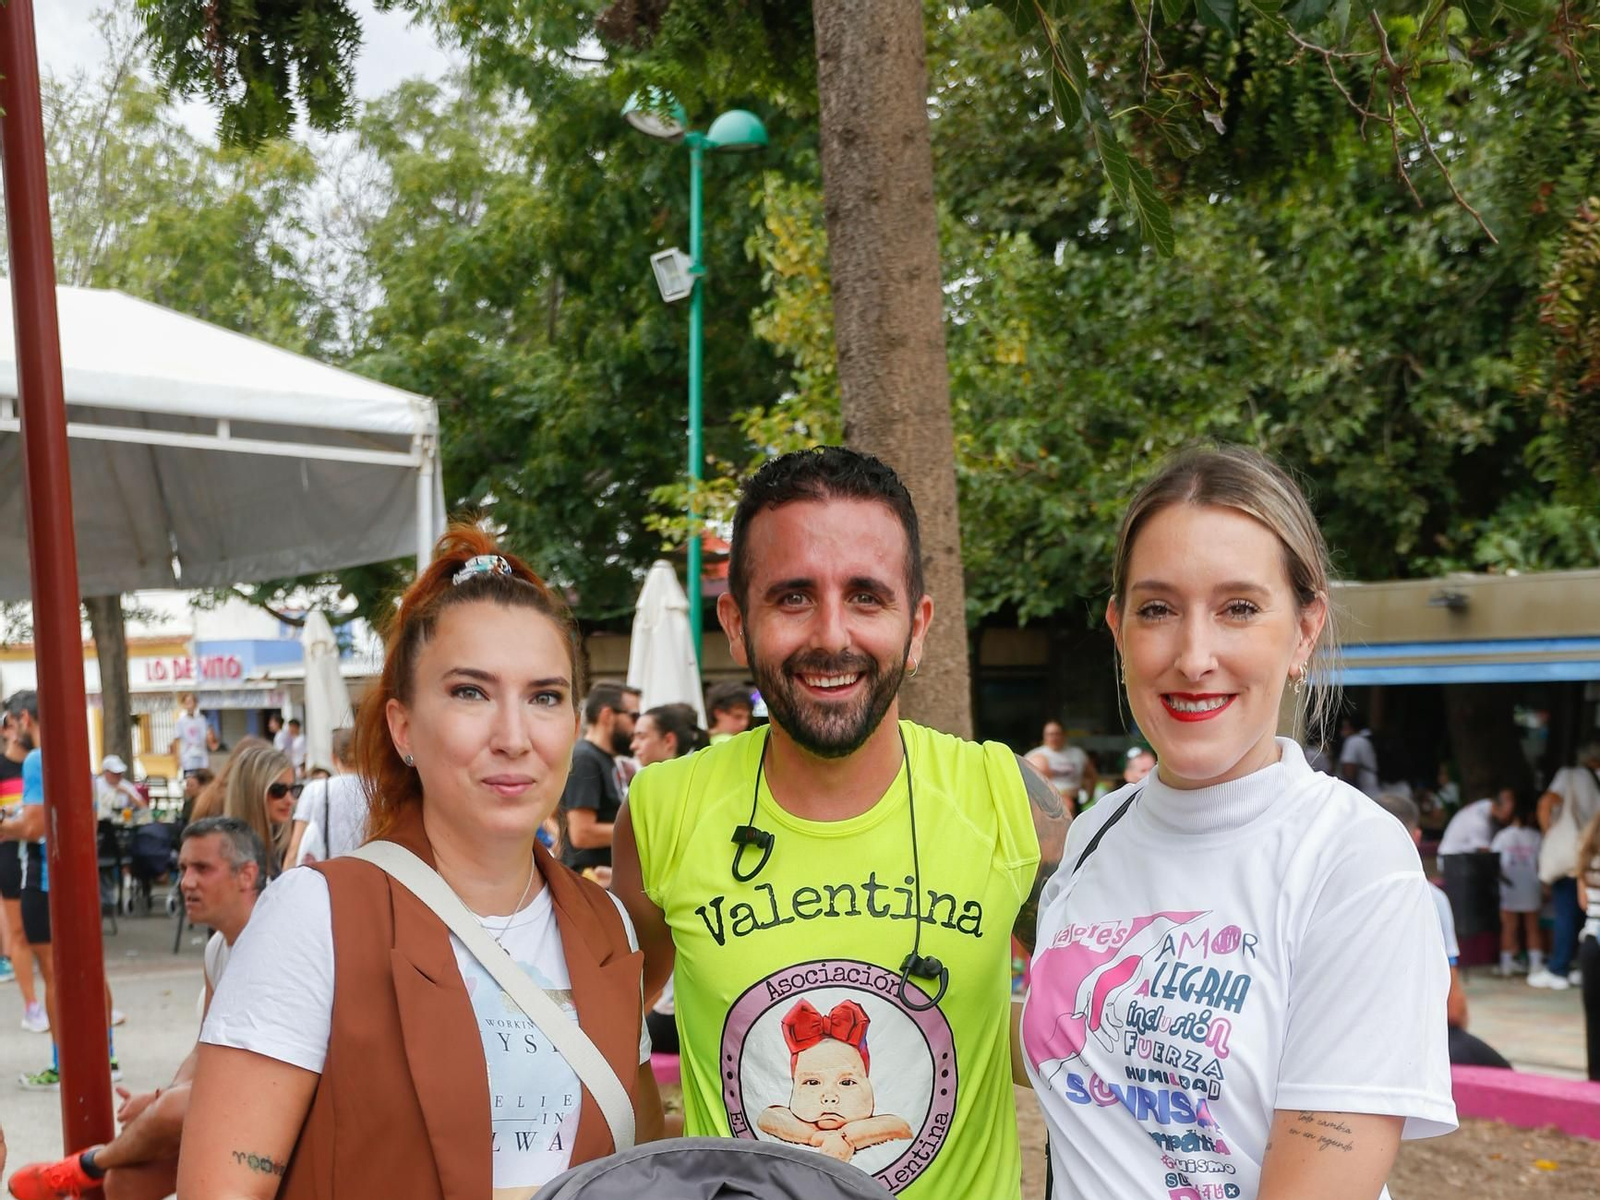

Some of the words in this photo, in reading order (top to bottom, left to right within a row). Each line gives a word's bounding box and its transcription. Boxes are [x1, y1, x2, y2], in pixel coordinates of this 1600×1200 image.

[146, 658, 167, 682] LO
[172, 656, 193, 682] DE
[200, 655, 242, 680] VITO
[695, 871, 983, 946] Valentina
[1153, 924, 1259, 962] AMOR
[766, 963, 902, 1001] Asociación
[1133, 960, 1252, 1015] ALEGRIA
[485, 1018, 535, 1030] WORKIN
[1124, 999, 1232, 1060] inclusión
[1124, 1030, 1225, 1081] FUERZA
[494, 1094, 573, 1108] ELIE
[1125, 1065, 1221, 1101] HUMILDAD
[729, 1110, 748, 1139] El
[878, 1111, 949, 1192] lentina
